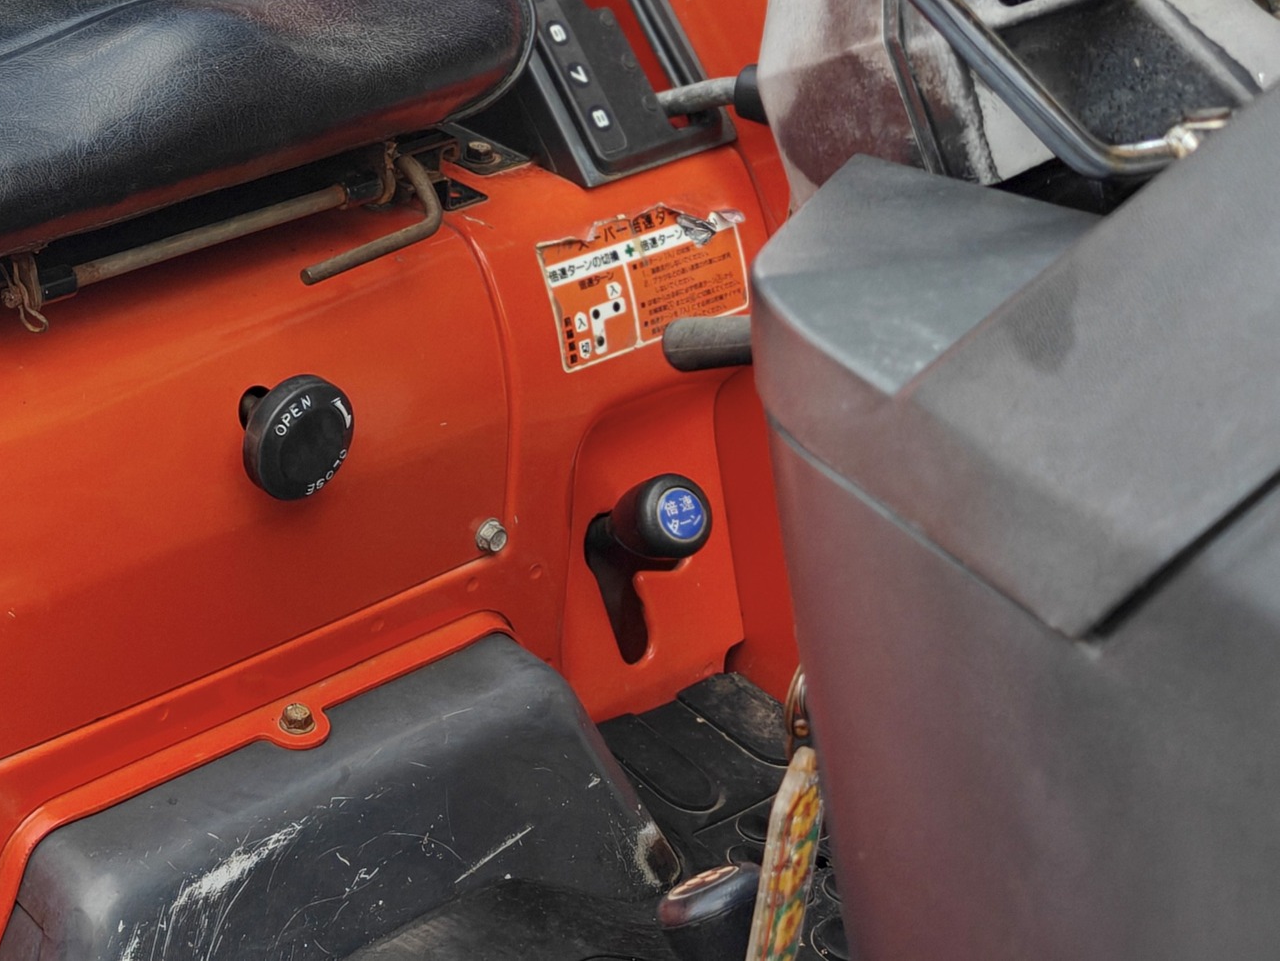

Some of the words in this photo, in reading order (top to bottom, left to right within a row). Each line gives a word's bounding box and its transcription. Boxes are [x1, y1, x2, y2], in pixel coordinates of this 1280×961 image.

[549, 24, 567, 42] 6
[570, 65, 588, 83] 7
[592, 109, 610, 128] 8
[274, 395, 312, 436] OPEN
[305, 449, 347, 495] CLOSE
[664, 495, 695, 517] 倍速
[667, 515, 701, 537] ターン
